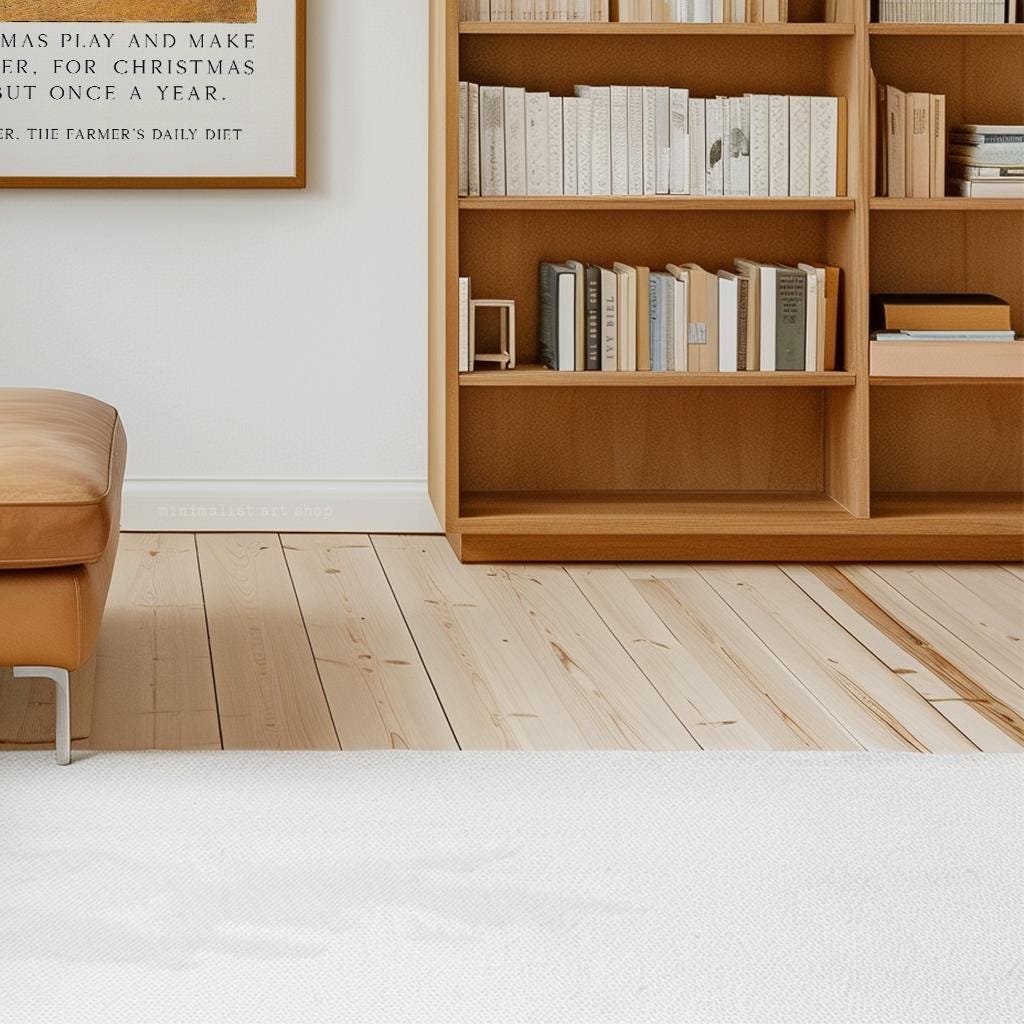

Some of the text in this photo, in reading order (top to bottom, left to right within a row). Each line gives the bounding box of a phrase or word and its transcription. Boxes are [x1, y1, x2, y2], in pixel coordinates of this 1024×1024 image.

[61, 33, 114, 48] PLAY
[128, 33, 176, 49] AND
[189, 33, 255, 49] MAKE
[53, 59, 96, 75] FOR
[113, 59, 255, 76] CHRISTMAS
[49, 85, 116, 101] ONCE
[129, 85, 142, 100] A
[156, 85, 226, 101] YEAR.
[27, 128, 59, 140] THE
[66, 128, 145, 141] FARMER'S
[152, 128, 198, 141] DAILY
[205, 128, 243, 141] DIET
[589, 281, 597, 361] ALL ABOUT CATS
[606, 296, 614, 359] IVY BIEL
